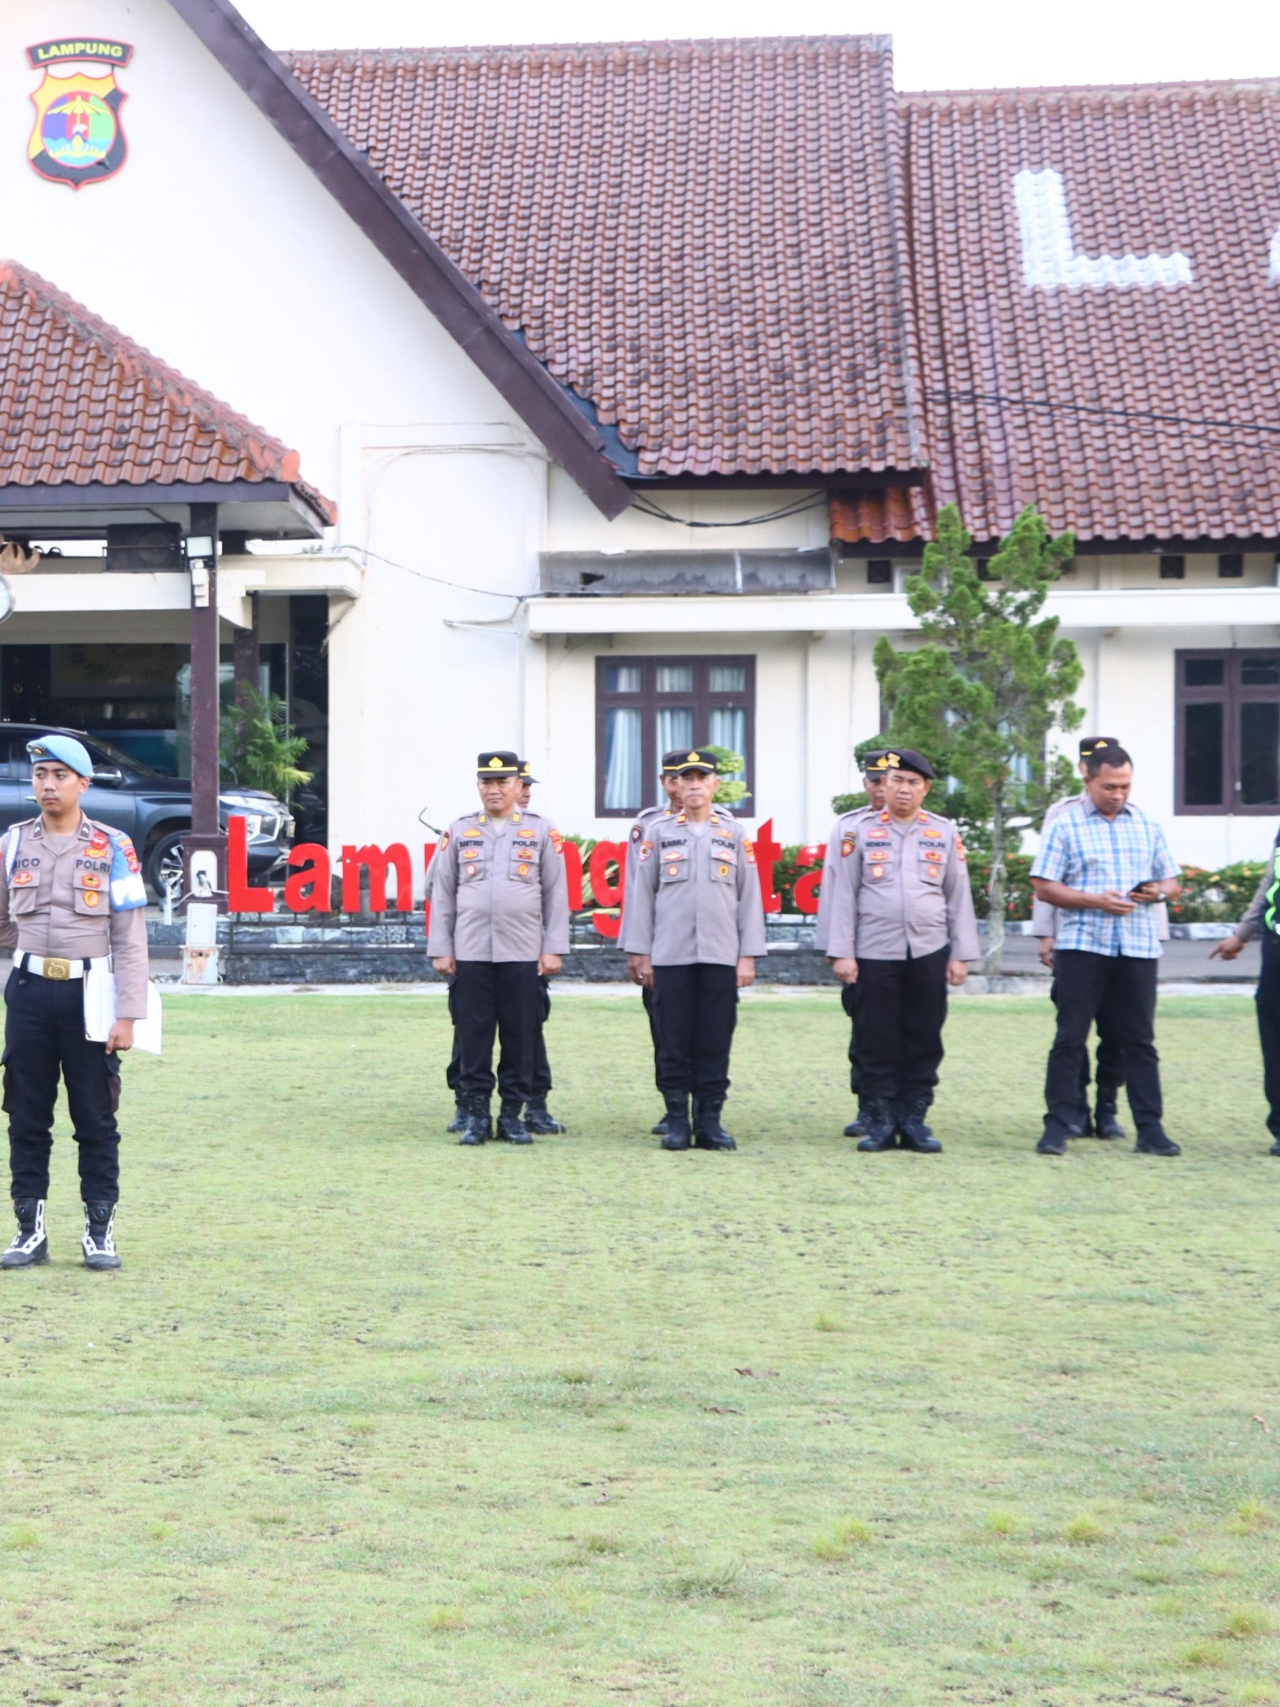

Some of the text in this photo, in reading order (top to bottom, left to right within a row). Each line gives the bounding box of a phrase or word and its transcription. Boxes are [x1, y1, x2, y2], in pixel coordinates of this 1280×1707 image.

[38, 43, 123, 60] LAMPUNG
[1013, 168, 1280, 289] L
[512, 840, 538, 848] POLRI
[919, 841, 947, 849] POLRI
[76, 859, 111, 873] POLRI
